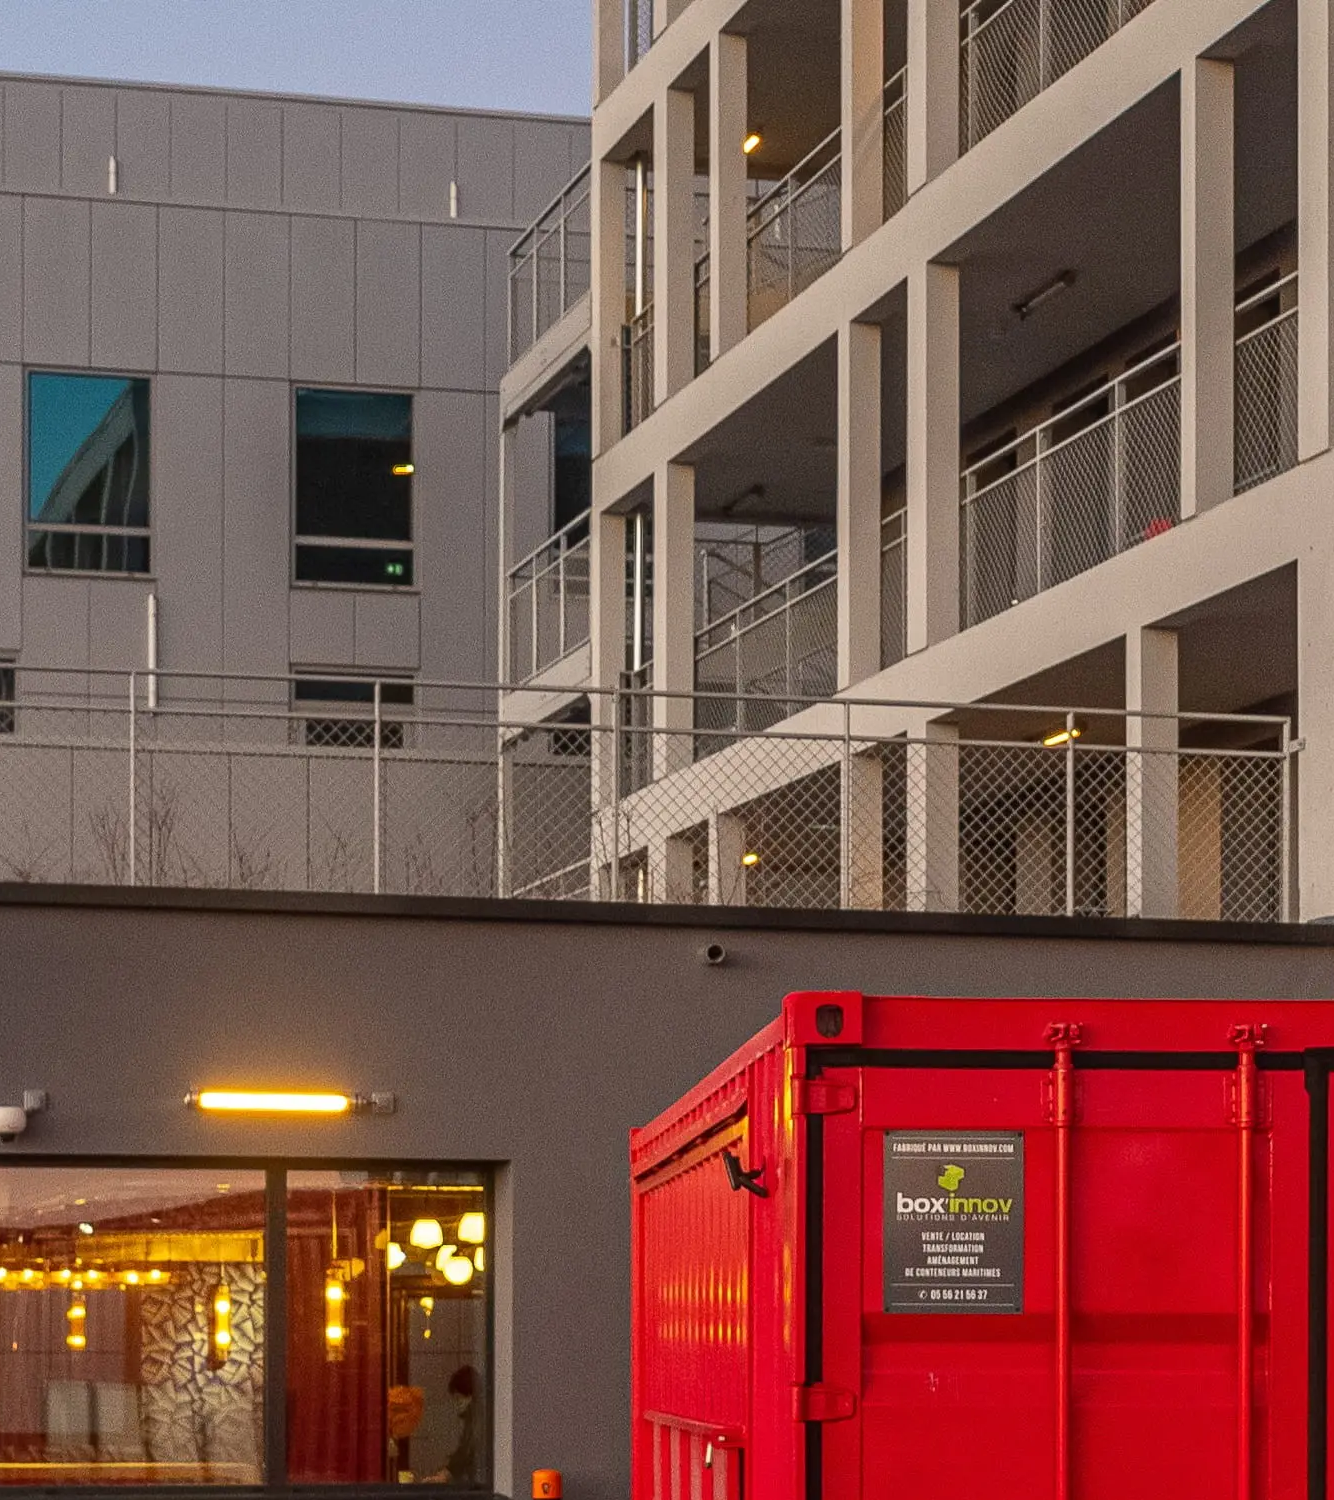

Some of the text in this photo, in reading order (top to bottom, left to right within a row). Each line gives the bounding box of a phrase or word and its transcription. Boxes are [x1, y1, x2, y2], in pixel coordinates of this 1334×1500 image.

[928, 1143, 941, 1153] PAR
[921, 1231, 944, 1241] VENTE
[951, 1231, 985, 1241] LOCATION
[922, 1243, 984, 1253] TRANSFORMATION
[927, 1255, 979, 1265] AMÉNAGEMENT
[905, 1267, 1001, 1278] DE CONTENEURS MARITIMES
[930, 1289, 941, 1300] 05
[954, 1289, 964, 1300] 21
[977, 1289, 988, 1300] 37
